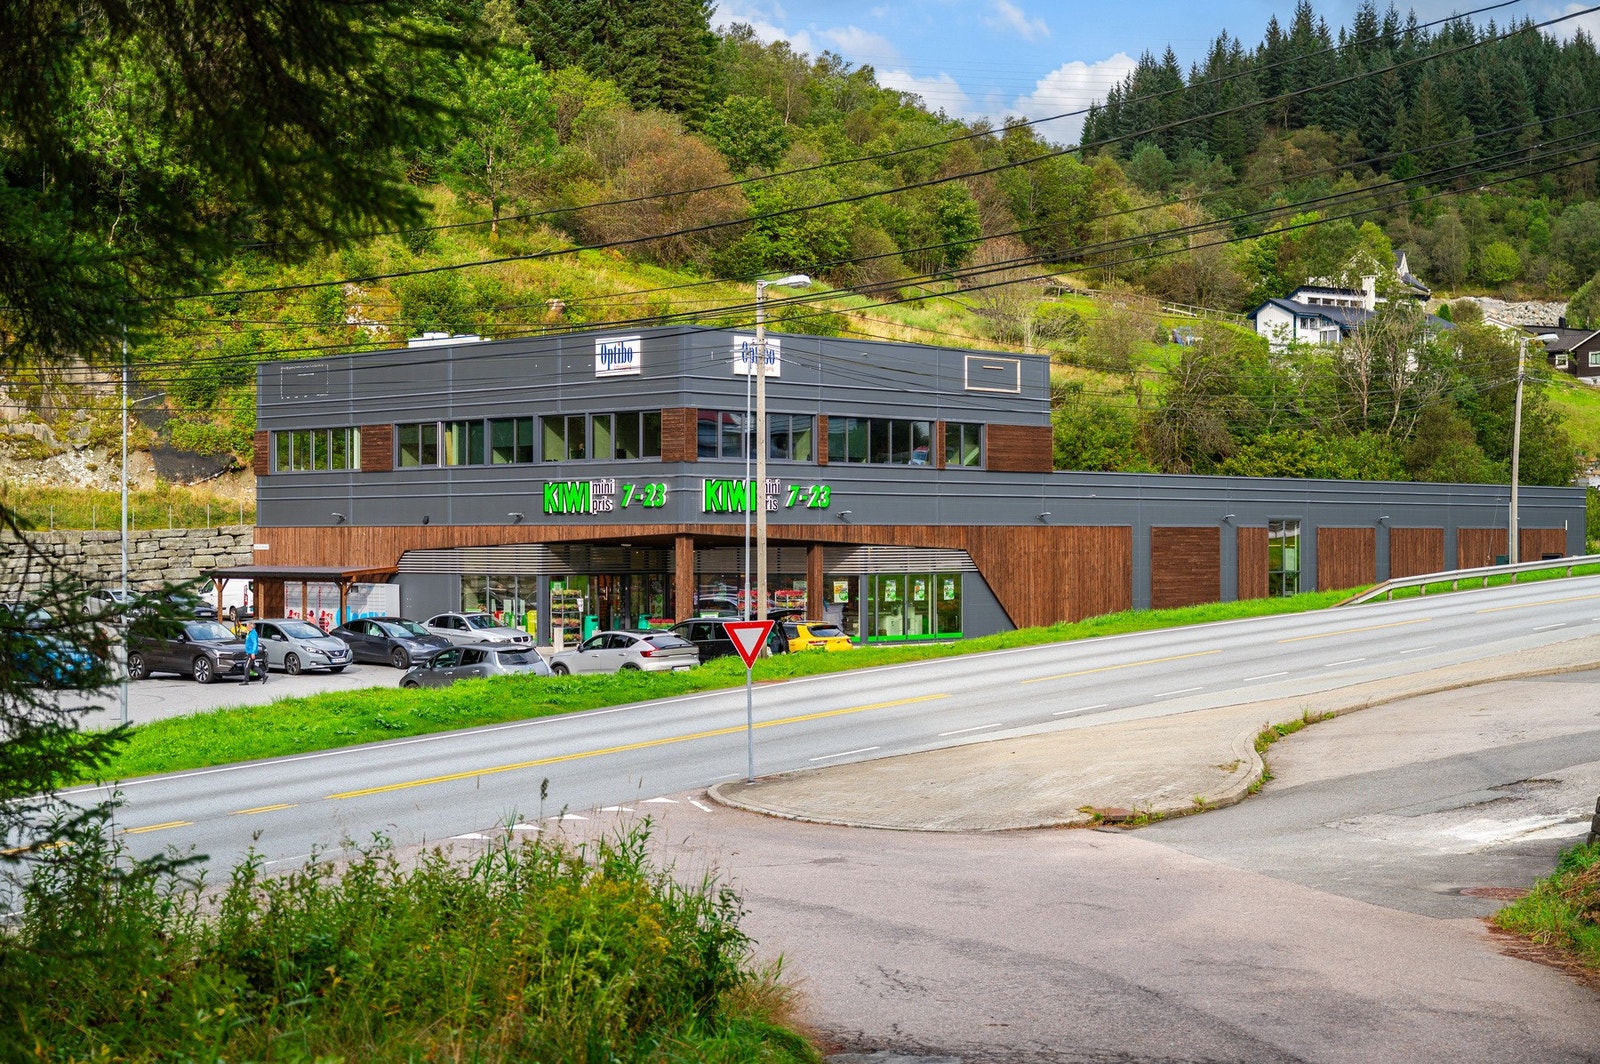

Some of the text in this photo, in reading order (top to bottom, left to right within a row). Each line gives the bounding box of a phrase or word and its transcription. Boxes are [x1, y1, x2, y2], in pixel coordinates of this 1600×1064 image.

[601, 341, 633, 370] Optibo
[543, 481, 591, 513] KIWI
[592, 479, 615, 495] mini
[702, 479, 757, 512] KIWI
[592, 497, 613, 514] pris
